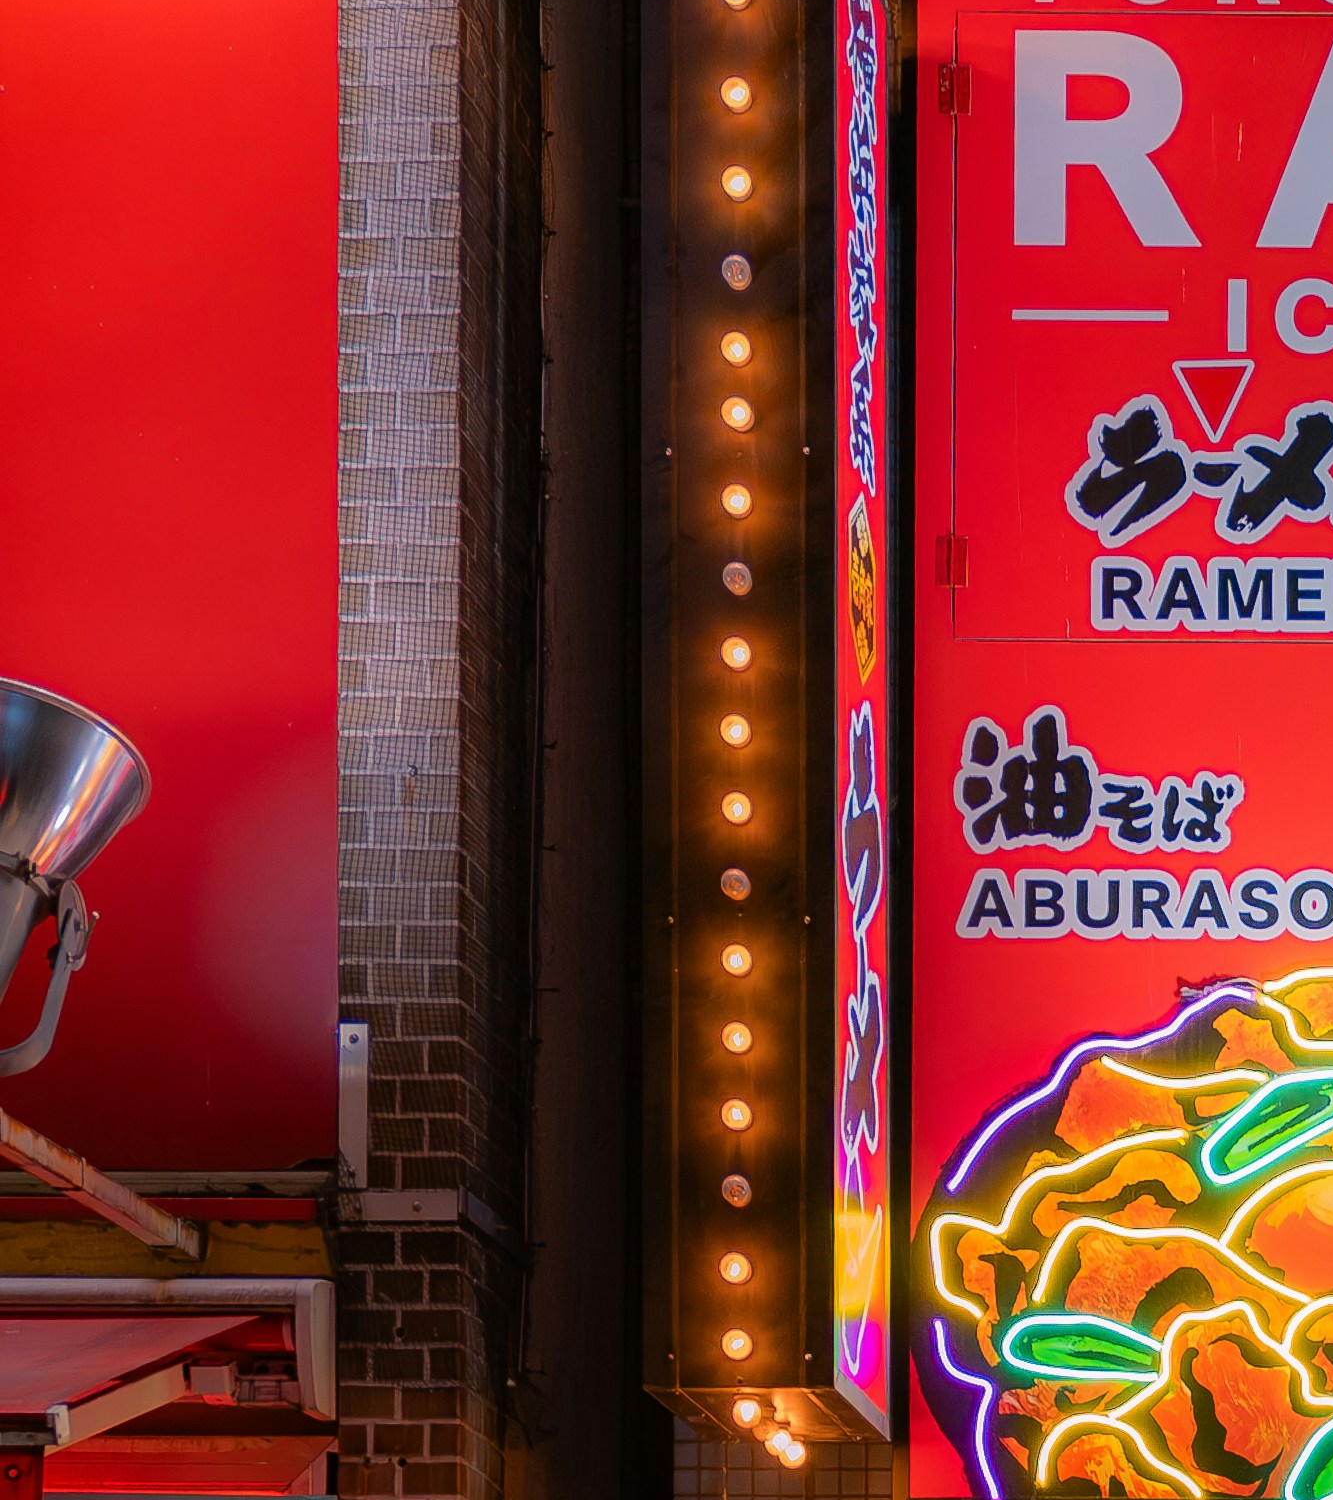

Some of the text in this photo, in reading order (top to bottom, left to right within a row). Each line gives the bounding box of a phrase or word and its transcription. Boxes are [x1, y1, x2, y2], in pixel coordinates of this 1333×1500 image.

[961, 714, 1235, 843] 油そば
[842, 701, 882, 1375] ラーメン
